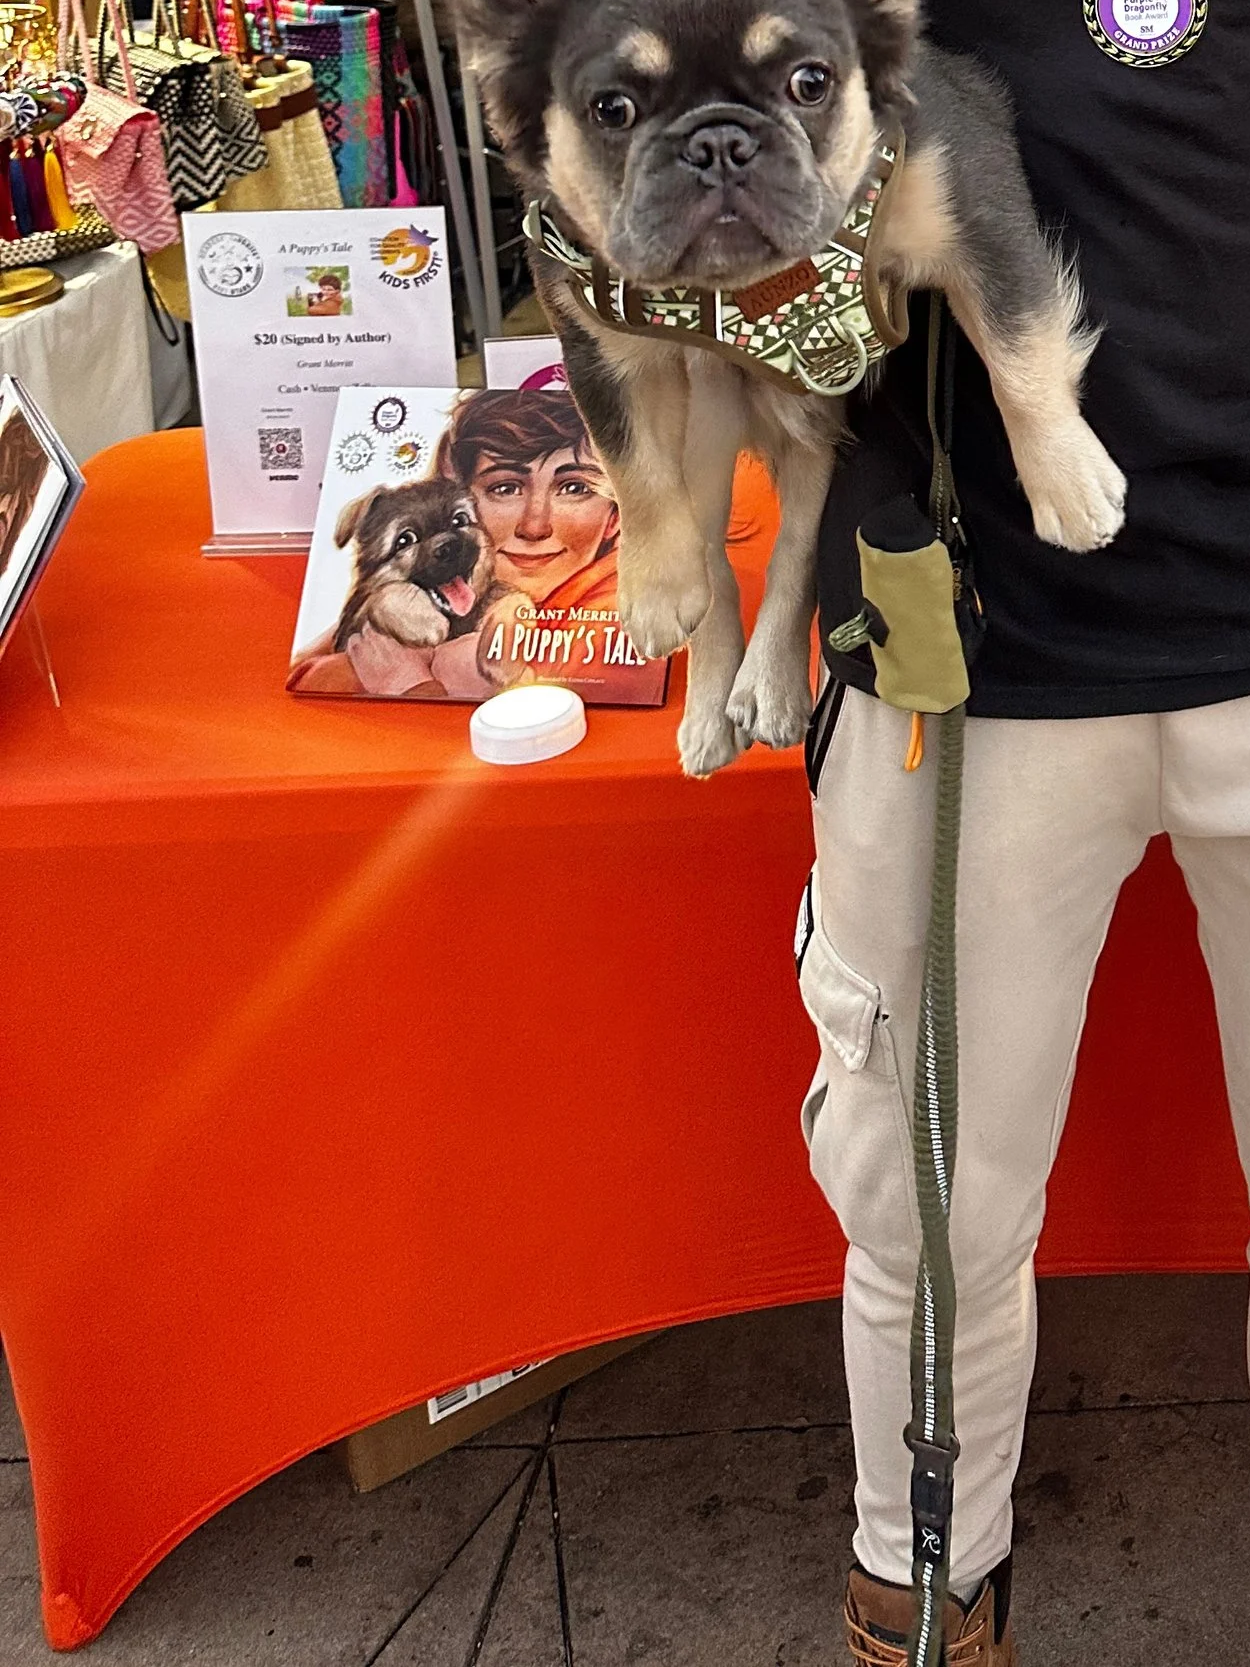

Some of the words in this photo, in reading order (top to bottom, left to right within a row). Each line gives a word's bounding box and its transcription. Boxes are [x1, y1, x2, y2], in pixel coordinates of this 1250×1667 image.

[1124, 2, 1168, 14] Dragonfly
[1114, 31, 1149, 50] GRAND
[1151, 28, 1181, 50] PRIZE
[332, 242, 353, 252] Tale
[378, 270, 411, 289] KIDS
[254, 334, 278, 345] $20
[327, 333, 341, 346] by
[344, 332, 392, 344] Author)
[277, 384, 302, 393] Cash
[515, 605, 566, 621] GRANT
[486, 623, 504, 661] A
[510, 623, 596, 665] PUPPY'S
